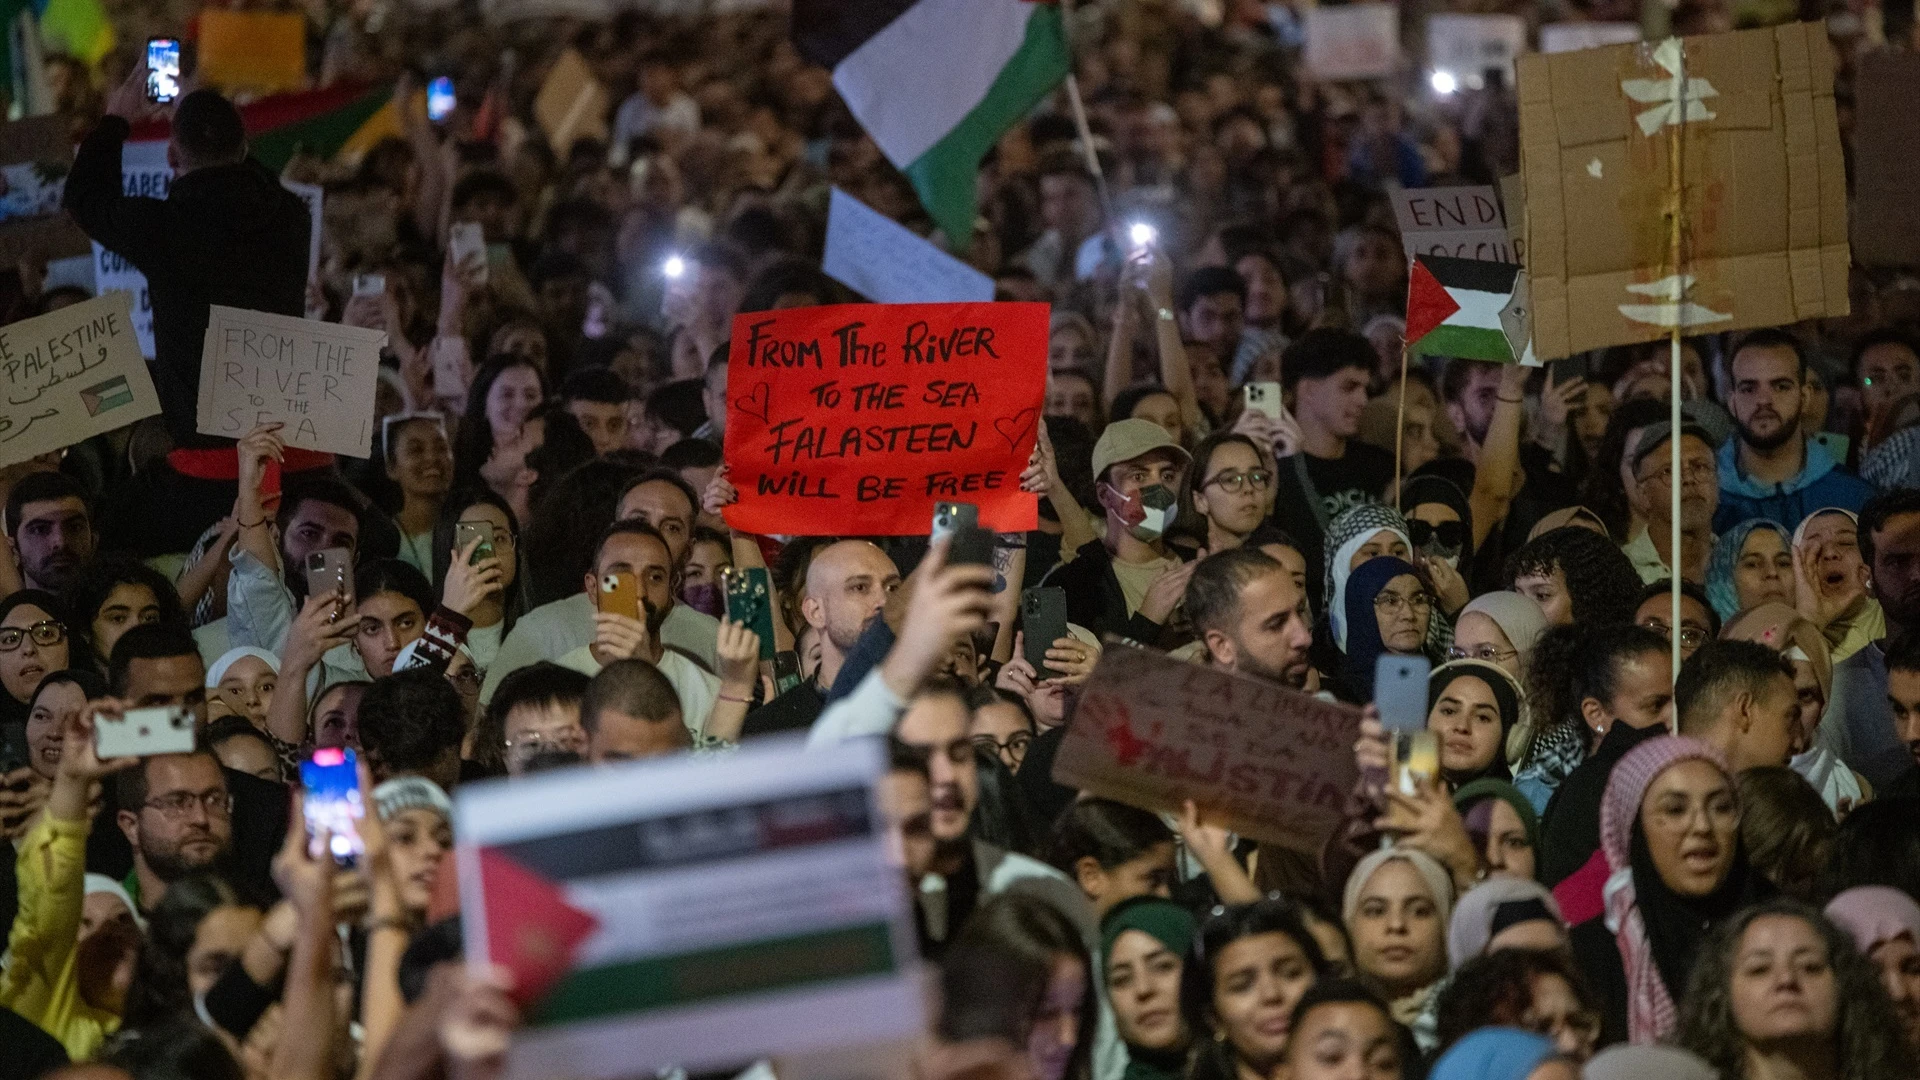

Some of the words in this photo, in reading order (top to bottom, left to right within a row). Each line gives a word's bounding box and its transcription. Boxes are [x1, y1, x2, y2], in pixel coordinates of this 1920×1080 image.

[1408, 195, 1497, 226] END
[2, 312, 121, 384] PALESTINE
[224, 328, 295, 367] FROM
[312, 341, 355, 377] THE
[747, 318, 823, 369] FROM
[223, 361, 343, 402] RIVER
[810, 380, 842, 409] TO
[851, 381, 909, 412] THE
[922, 380, 982, 408] SEA
[247, 393, 265, 406] TO
[283, 398, 310, 415] THE
[764, 417, 978, 465] FALASTEEN
[857, 475, 906, 503] BE
[925, 470, 1007, 497] FREE
